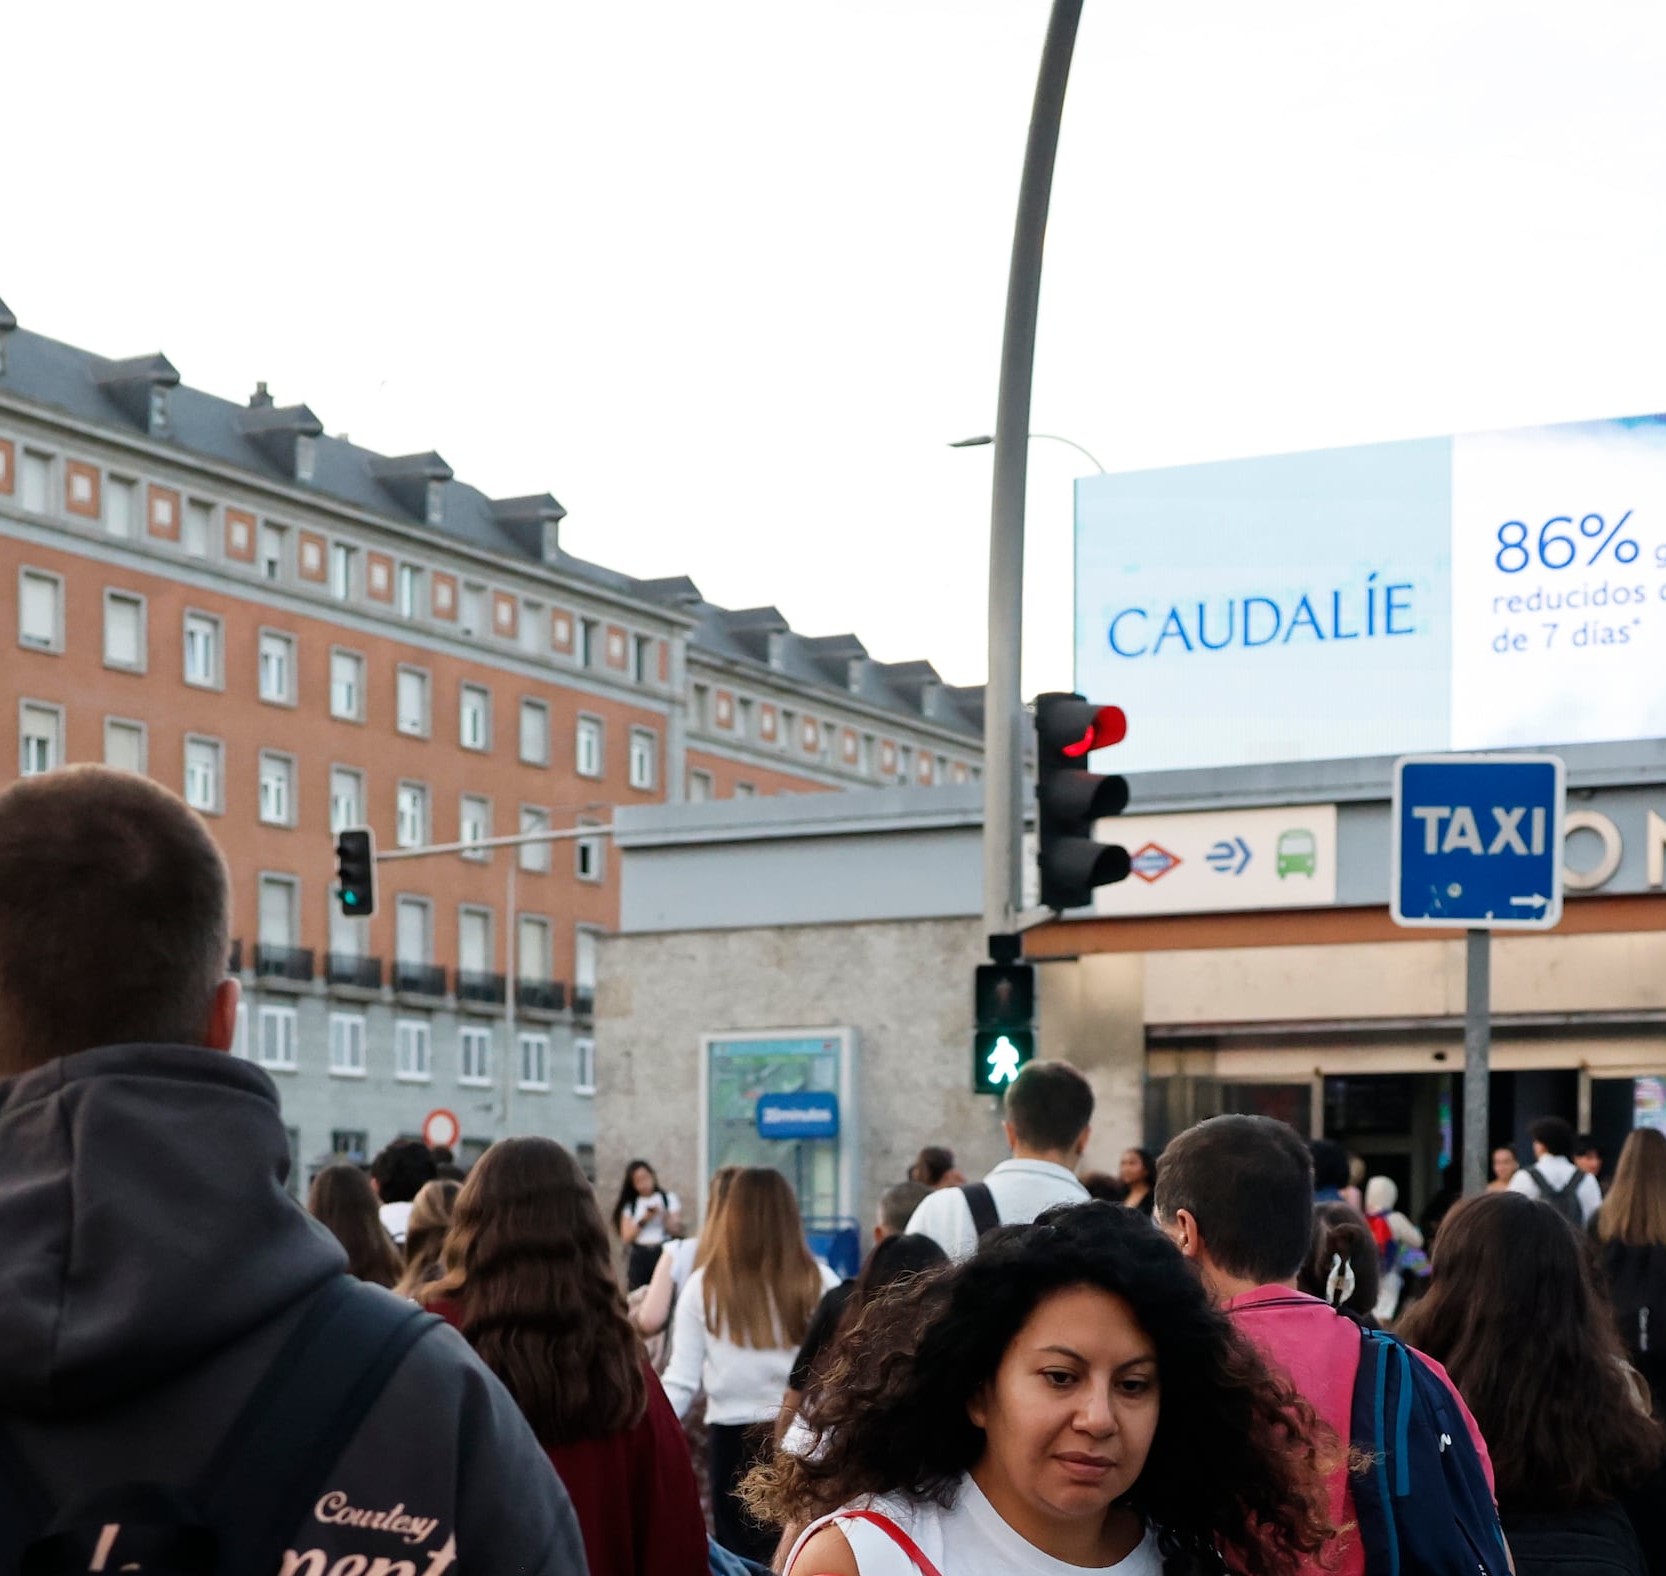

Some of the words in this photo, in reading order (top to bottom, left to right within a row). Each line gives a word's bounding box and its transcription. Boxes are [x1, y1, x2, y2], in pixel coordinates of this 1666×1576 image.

[1494, 508, 1641, 574] 86%
[1107, 572, 1417, 660] CAUDALÍE
[1492, 581, 1647, 615] reducidos
[1491, 627, 1529, 655] de
[1541, 622, 1560, 650] 7
[1412, 805, 1546, 858] TAXI
[313, 1490, 439, 1544] Courtesy
